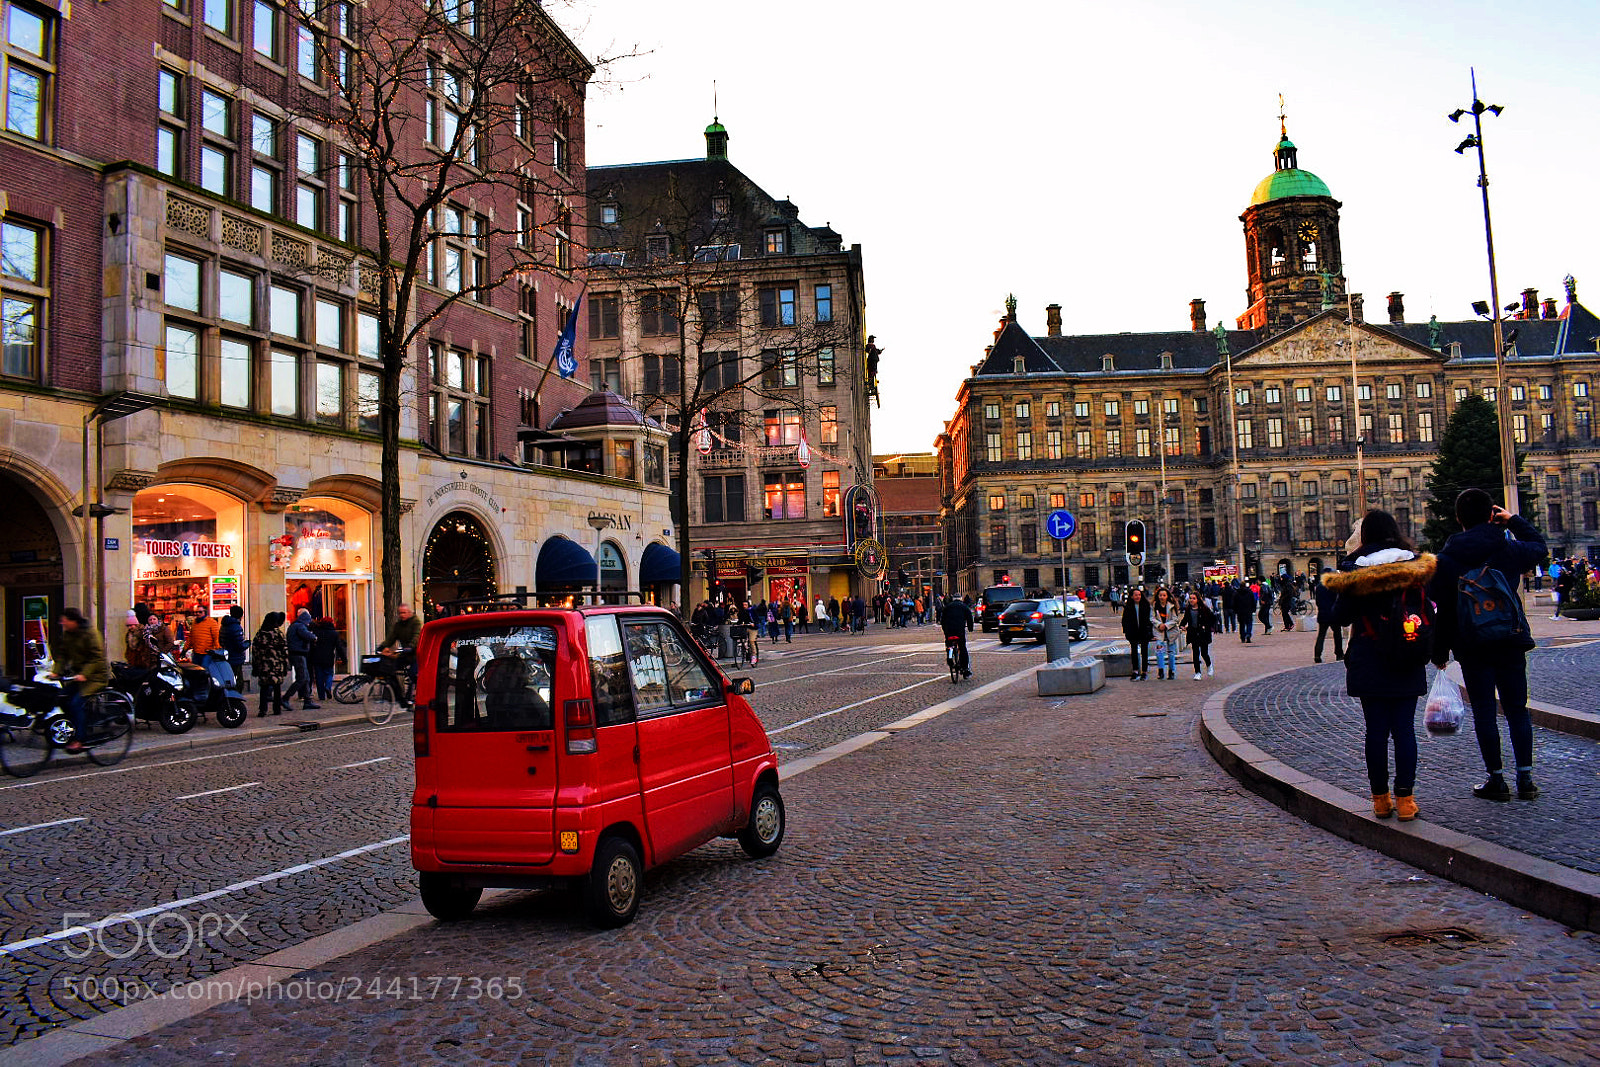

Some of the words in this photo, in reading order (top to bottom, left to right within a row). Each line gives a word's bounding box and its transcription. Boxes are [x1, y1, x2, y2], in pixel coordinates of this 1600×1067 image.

[145, 540, 180, 556] TOURS
[182, 542, 190, 557] &
[192, 542, 231, 558] TICKETS
[299, 563, 332, 572] HOLLAND
